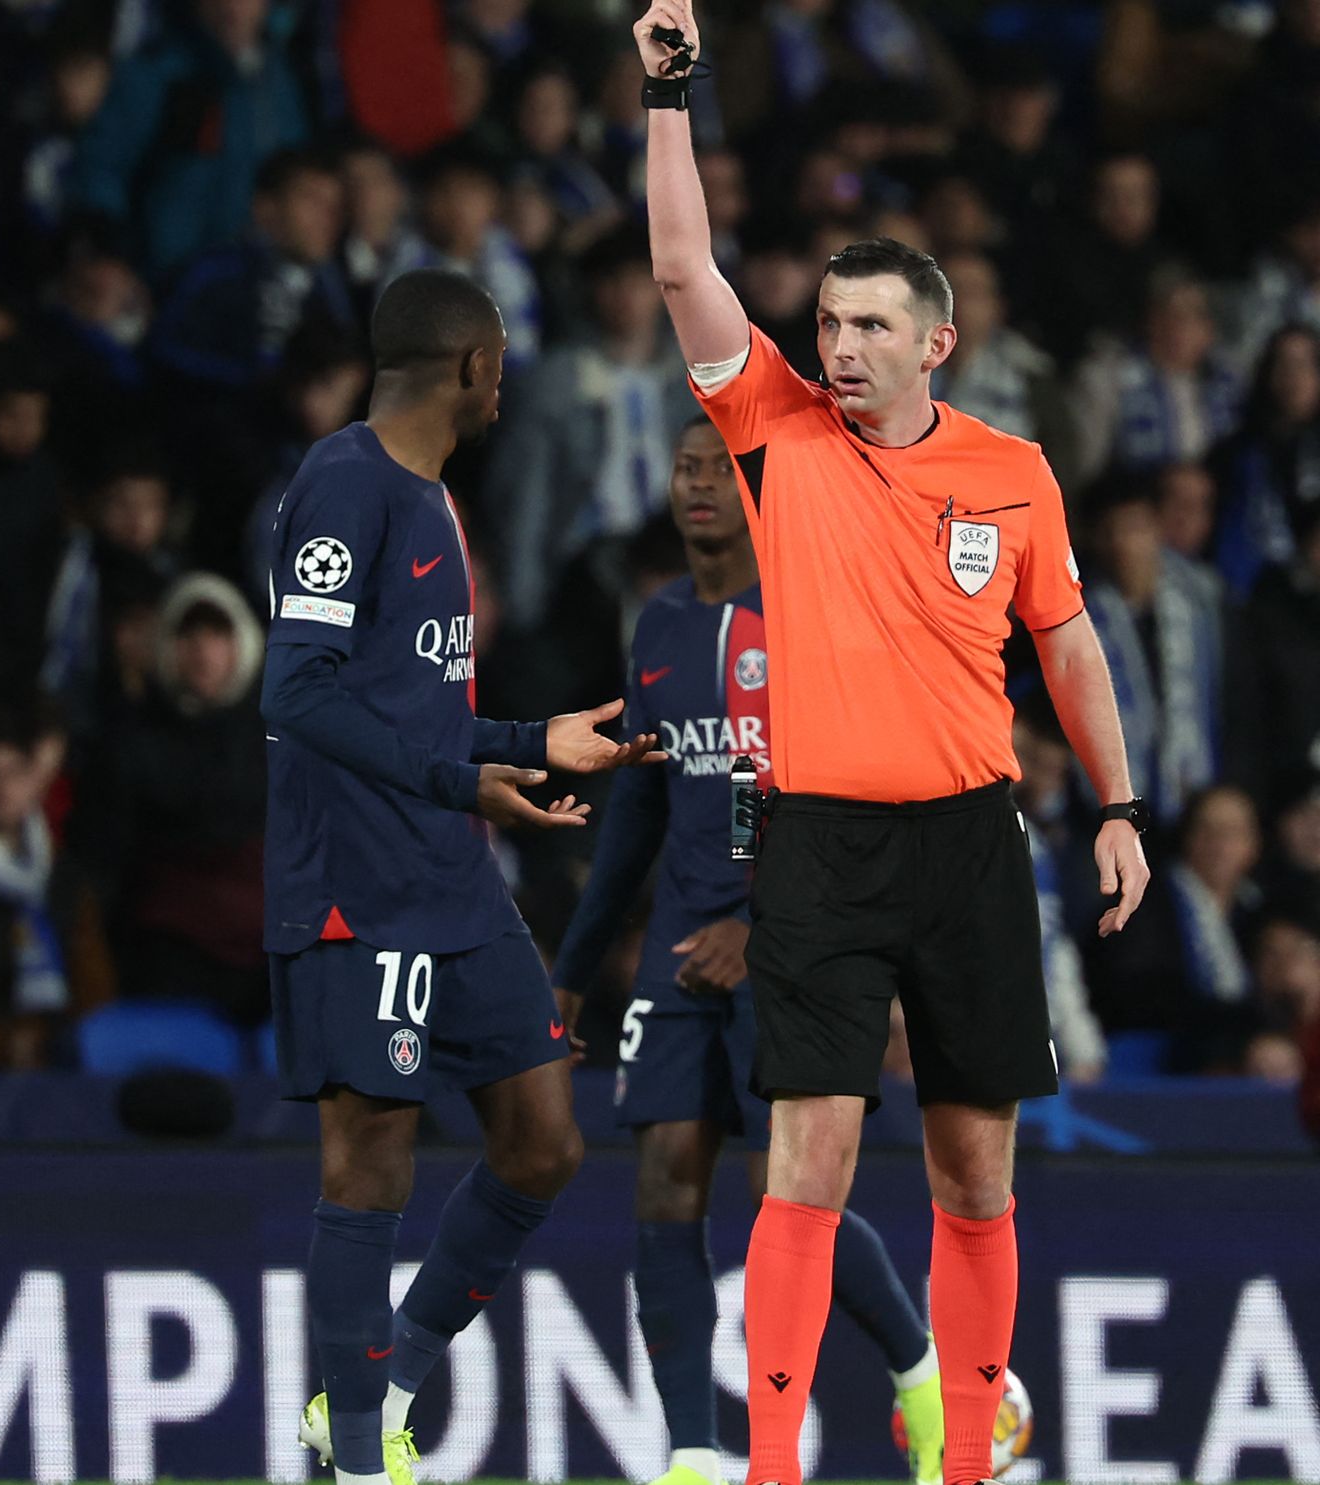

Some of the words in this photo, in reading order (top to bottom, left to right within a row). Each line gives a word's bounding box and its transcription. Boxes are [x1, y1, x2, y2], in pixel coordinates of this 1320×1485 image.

[960, 530, 989, 545] UEFA
[955, 562, 990, 574] OFFICIAL
[960, 551, 989, 562] MATCH
[284, 601, 352, 619] FOUNDATION
[659, 716, 767, 762] QATAR
[375, 950, 432, 1027] 10
[619, 998, 655, 1062] 5
[925, 1276, 1320, 1484] EA
